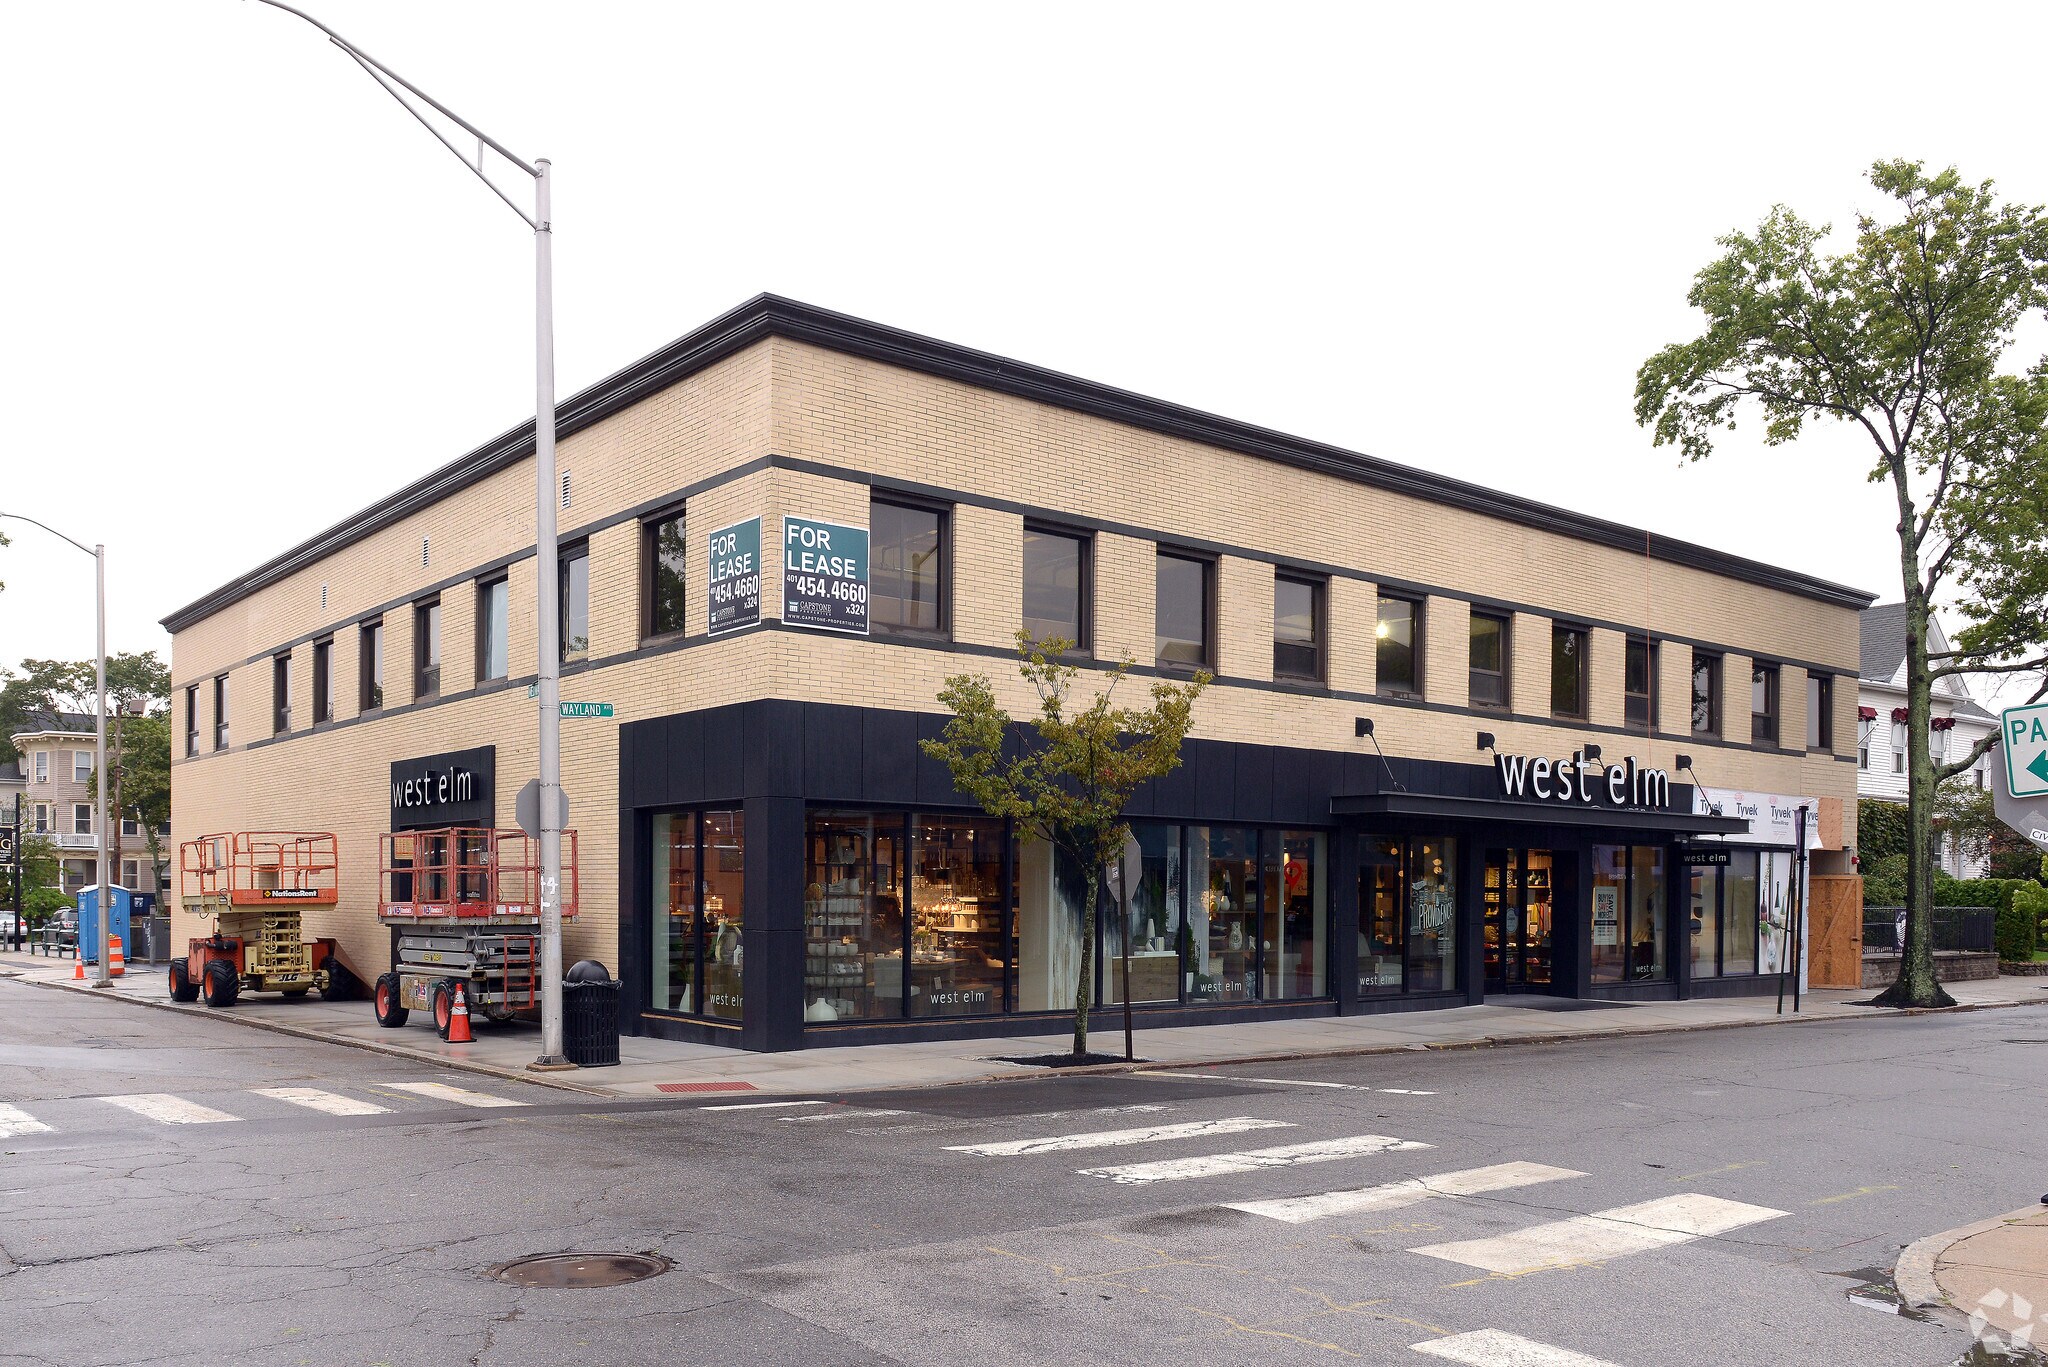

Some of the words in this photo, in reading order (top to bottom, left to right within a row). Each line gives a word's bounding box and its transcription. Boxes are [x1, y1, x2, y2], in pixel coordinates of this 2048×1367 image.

[787, 524, 832, 550] FOR
[710, 532, 737, 559] FOR
[710, 552, 752, 583] LEASE
[787, 549, 856, 579] LEASE
[715, 575, 759, 604] 454.4660
[786, 574, 798, 583] 401
[796, 575, 867, 603] 454.4660
[743, 595, 758, 610] x324
[800, 600, 832, 612] CAPSTONE
[845, 603, 865, 616] x324
[561, 703, 601, 716] WAYLAND
[1500, 751, 1592, 802] west
[1609, 755, 1669, 807] elm
[392, 770, 431, 808] west
[438, 766, 471, 803] elm
[1736, 802, 1758, 817] Tyvek
[1770, 805, 1792, 820] Tyvek
[1683, 853, 1706, 862] west
[1709, 852, 1727, 862] elm
[271, 890, 317, 898] NationsRent
[279, 973, 300, 982] JLG
[1359, 975, 1378, 986] west
[1380, 975, 1395, 985] elm
[1200, 981, 1222, 992] west
[1225, 980, 1242, 992] elm
[709, 993, 729, 1006] west
[930, 991, 959, 1004] west
[963, 990, 985, 1003] elm
